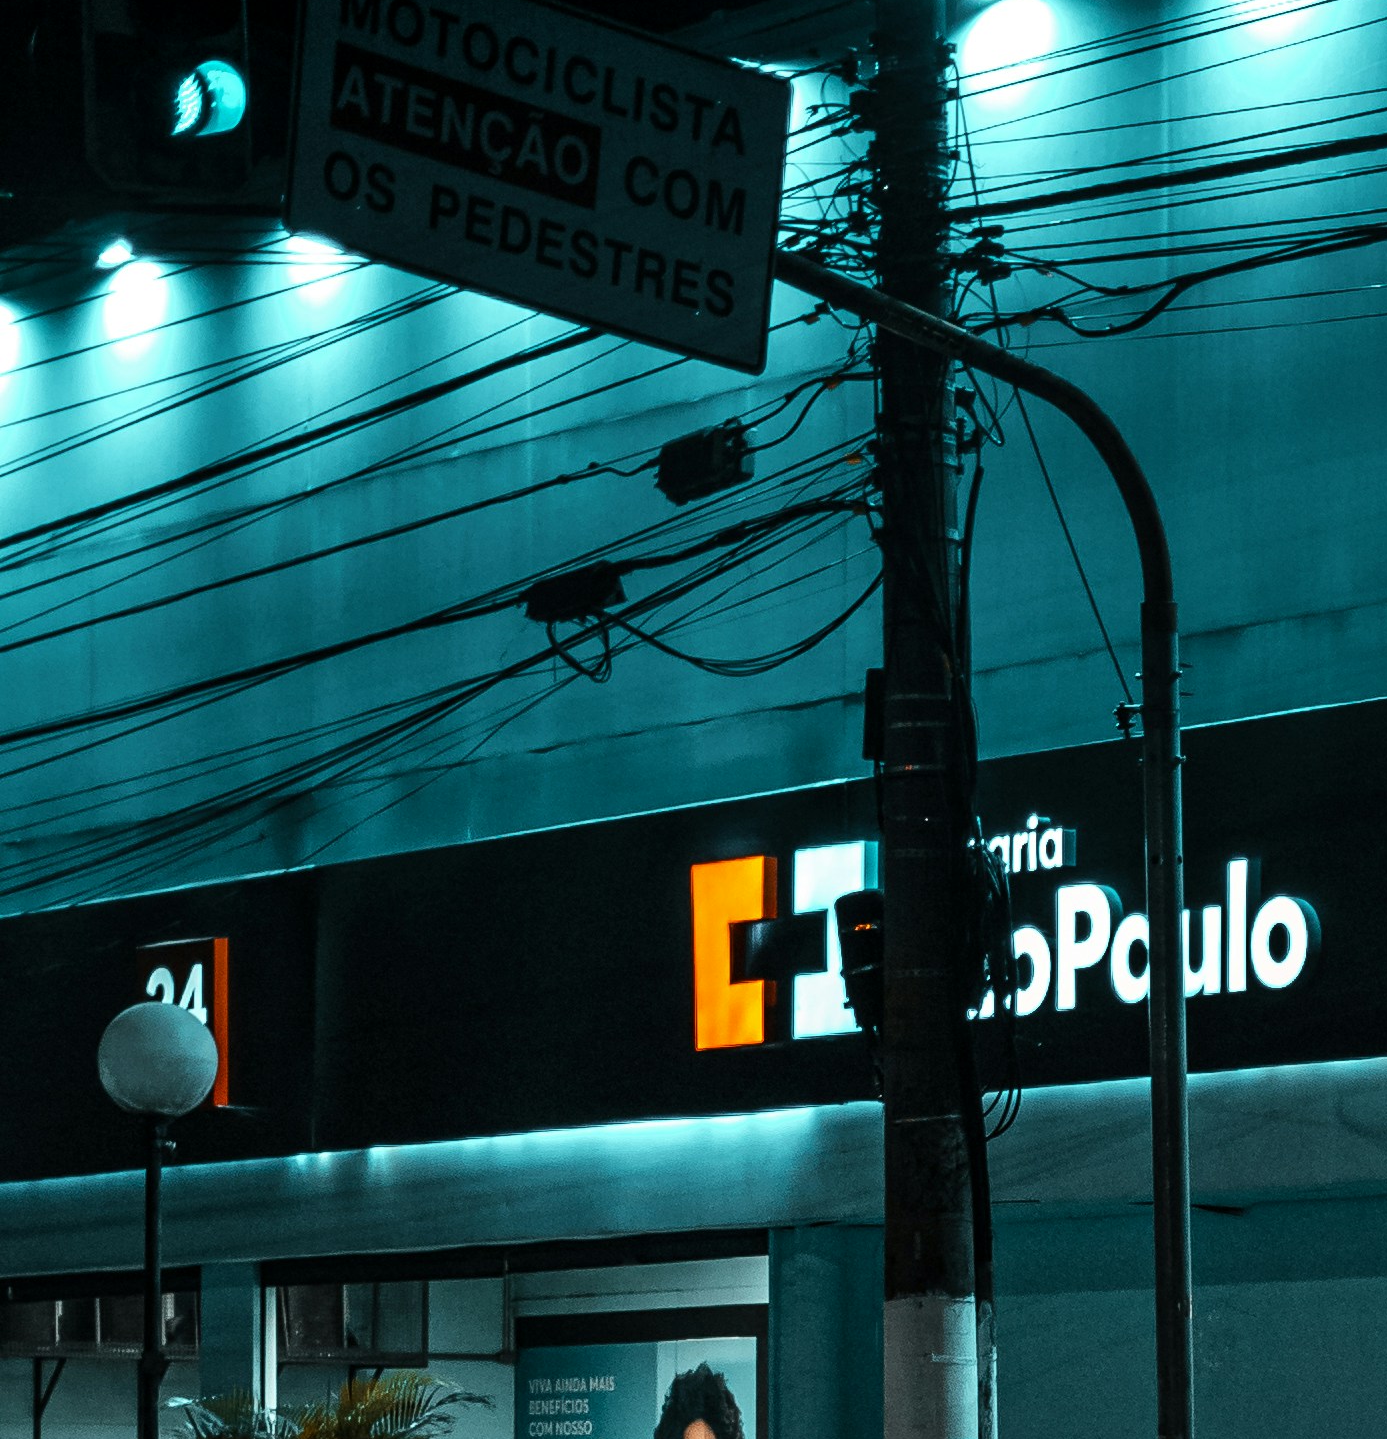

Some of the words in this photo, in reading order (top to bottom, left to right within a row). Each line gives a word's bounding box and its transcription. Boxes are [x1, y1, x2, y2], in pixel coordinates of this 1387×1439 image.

[336, 64, 591, 188] ATENÇÃO
[624, 155, 747, 236] COM
[323, 150, 396, 214] OS
[429, 183, 735, 318] PEDESTRES
[968, 812, 1064, 875] aria
[968, 857, 1308, 1020] oPaulo
[528, 1378, 553, 1395] VIVA
[555, 1377, 588, 1394] AINDA
[589, 1375, 616, 1393] MAIS
[528, 1397, 590, 1416] BENEFÍCIOS
[528, 1421, 554, 1438] COM
[555, 1420, 593, 1436] NOSSO
